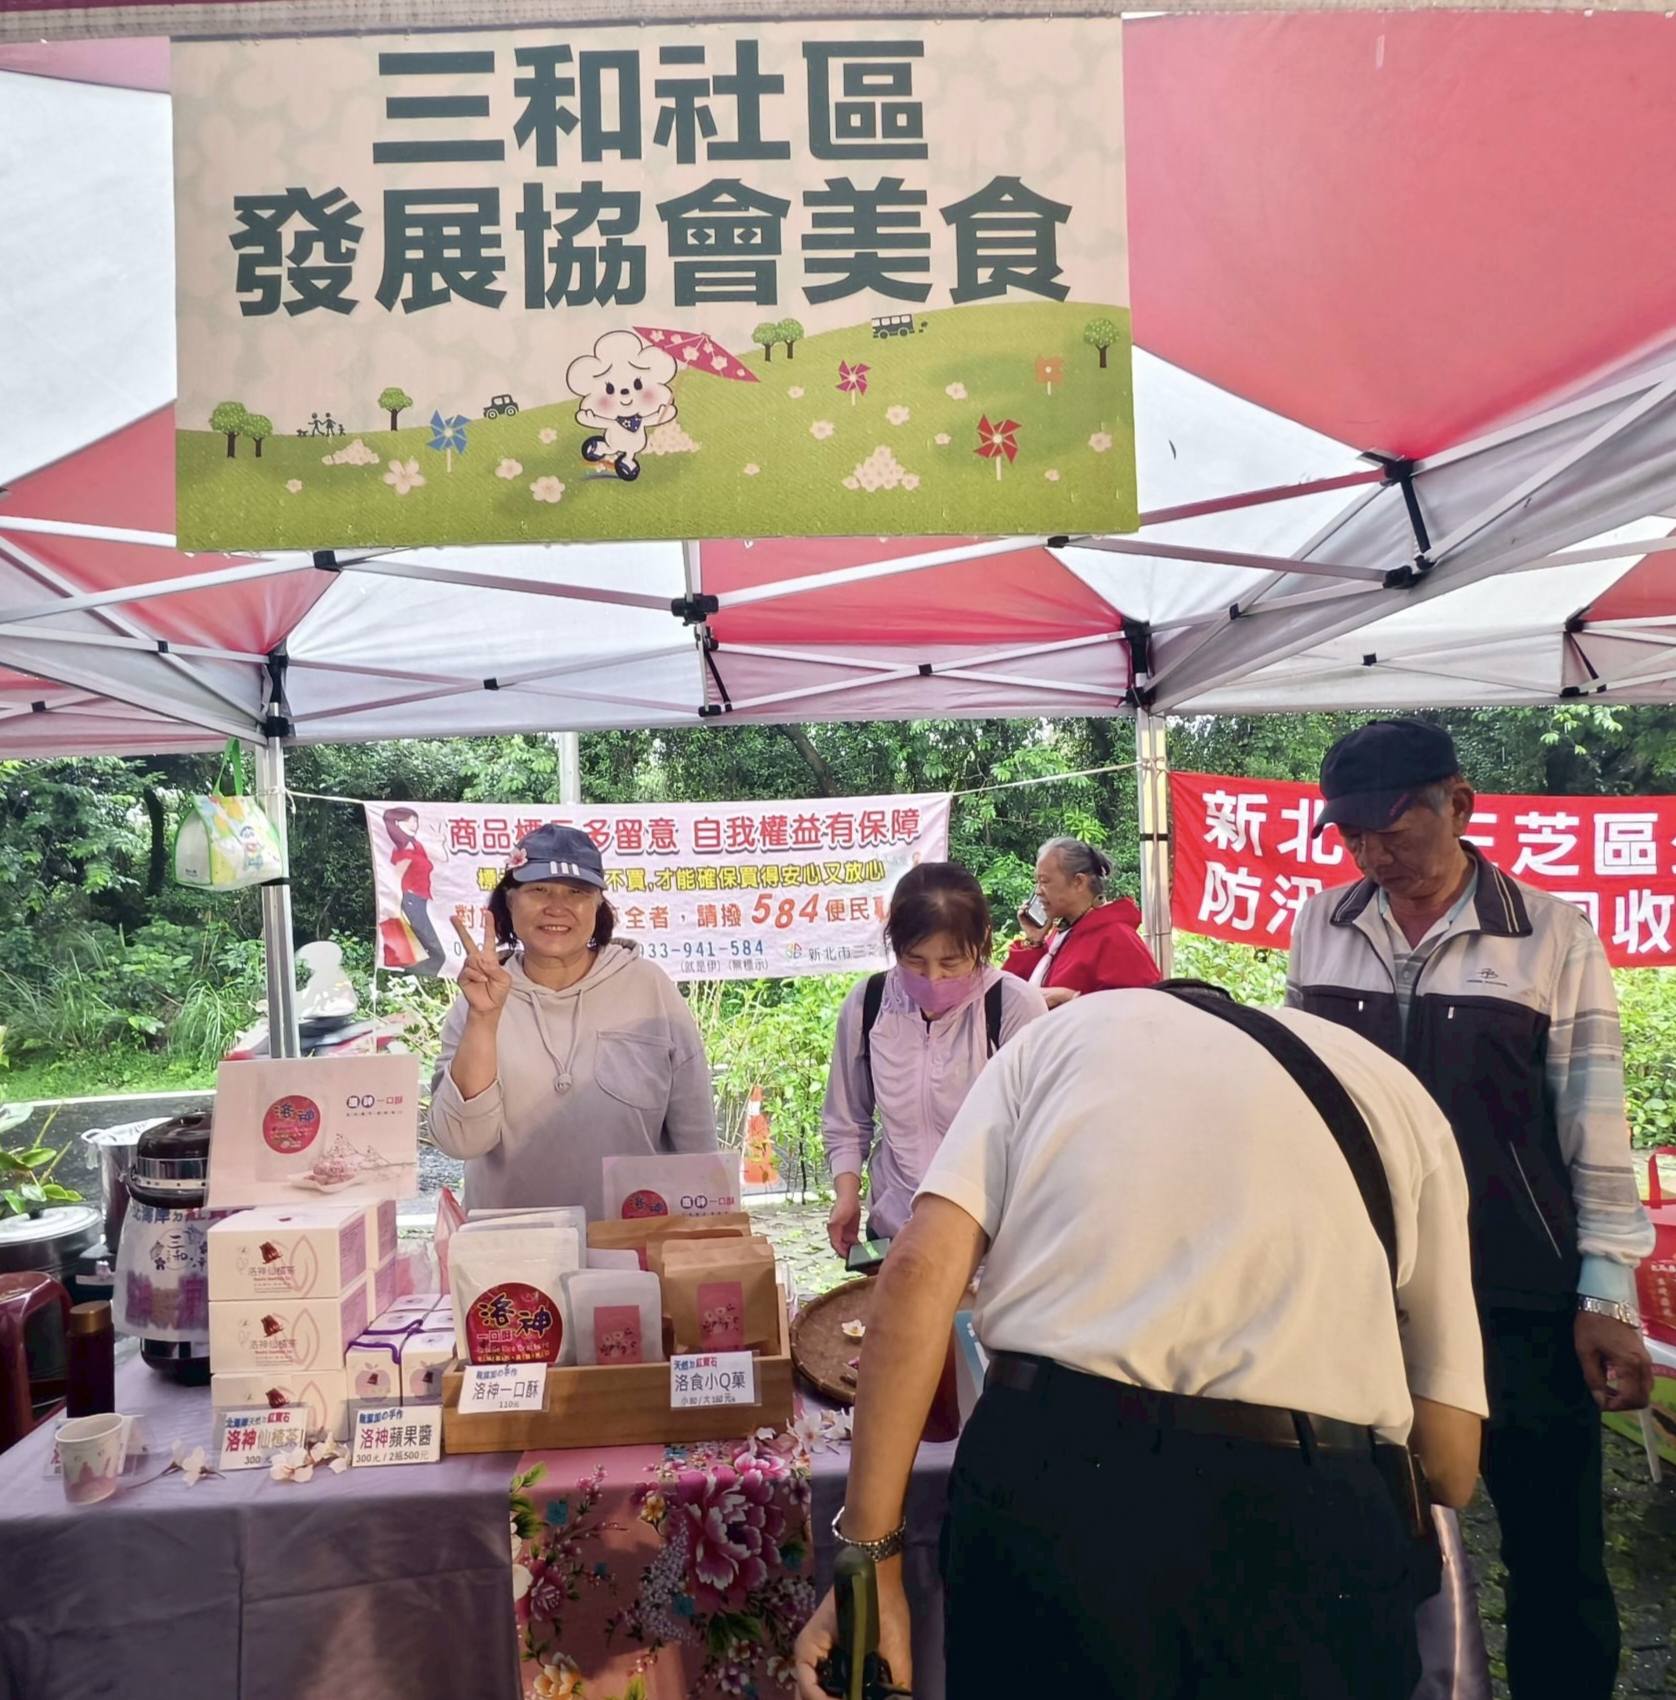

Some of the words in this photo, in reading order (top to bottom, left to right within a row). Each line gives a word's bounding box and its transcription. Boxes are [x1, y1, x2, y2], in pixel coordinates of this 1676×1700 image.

[372, 38, 929, 167] 三和社區
[230, 175, 1075, 317] 發展協會美食
[448, 816, 679, 852] 商品多留意
[690, 808, 922, 851] 自我權益有保障
